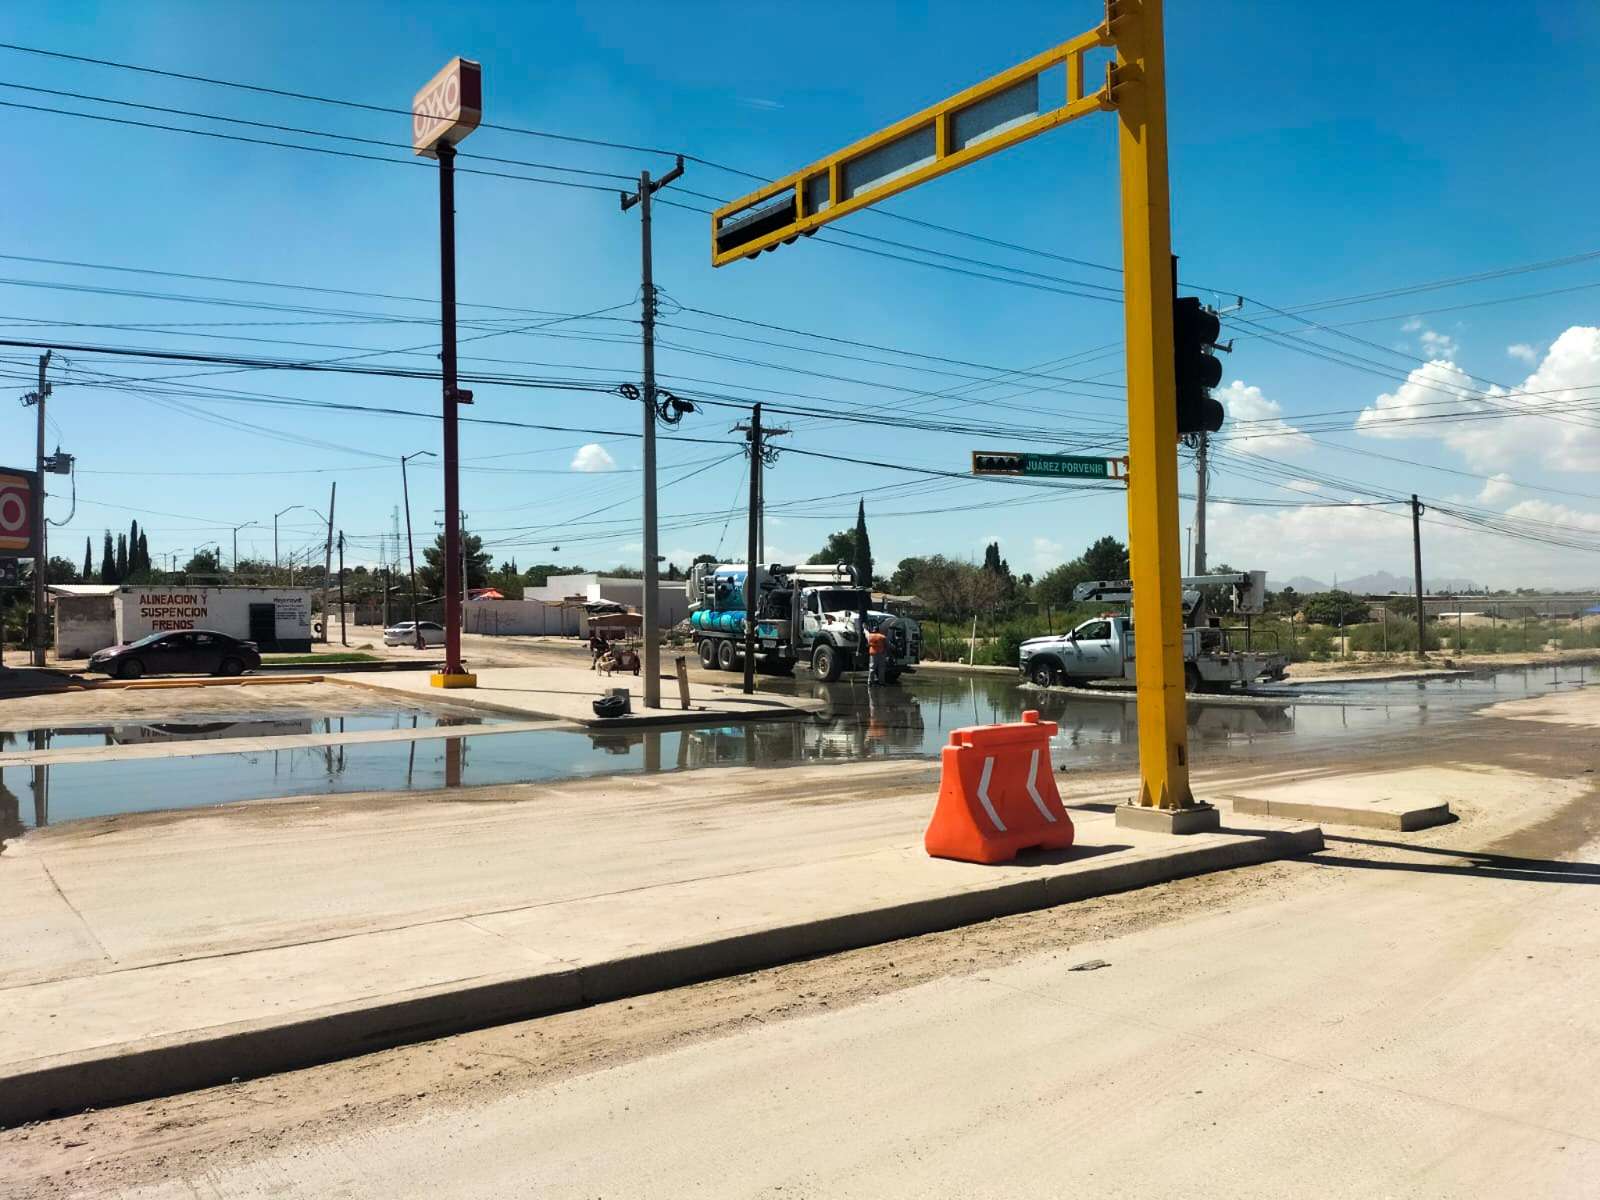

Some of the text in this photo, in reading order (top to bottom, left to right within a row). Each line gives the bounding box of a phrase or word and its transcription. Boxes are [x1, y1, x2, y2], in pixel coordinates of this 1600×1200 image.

[414, 75, 458, 139] OXXO
[1026, 459, 1104, 475] JUÁREZ PORVENIR
[139, 594, 209, 605] ALINEACION Y
[140, 607, 208, 618] SUSPENCION
[152, 620, 195, 631] FRENOS
